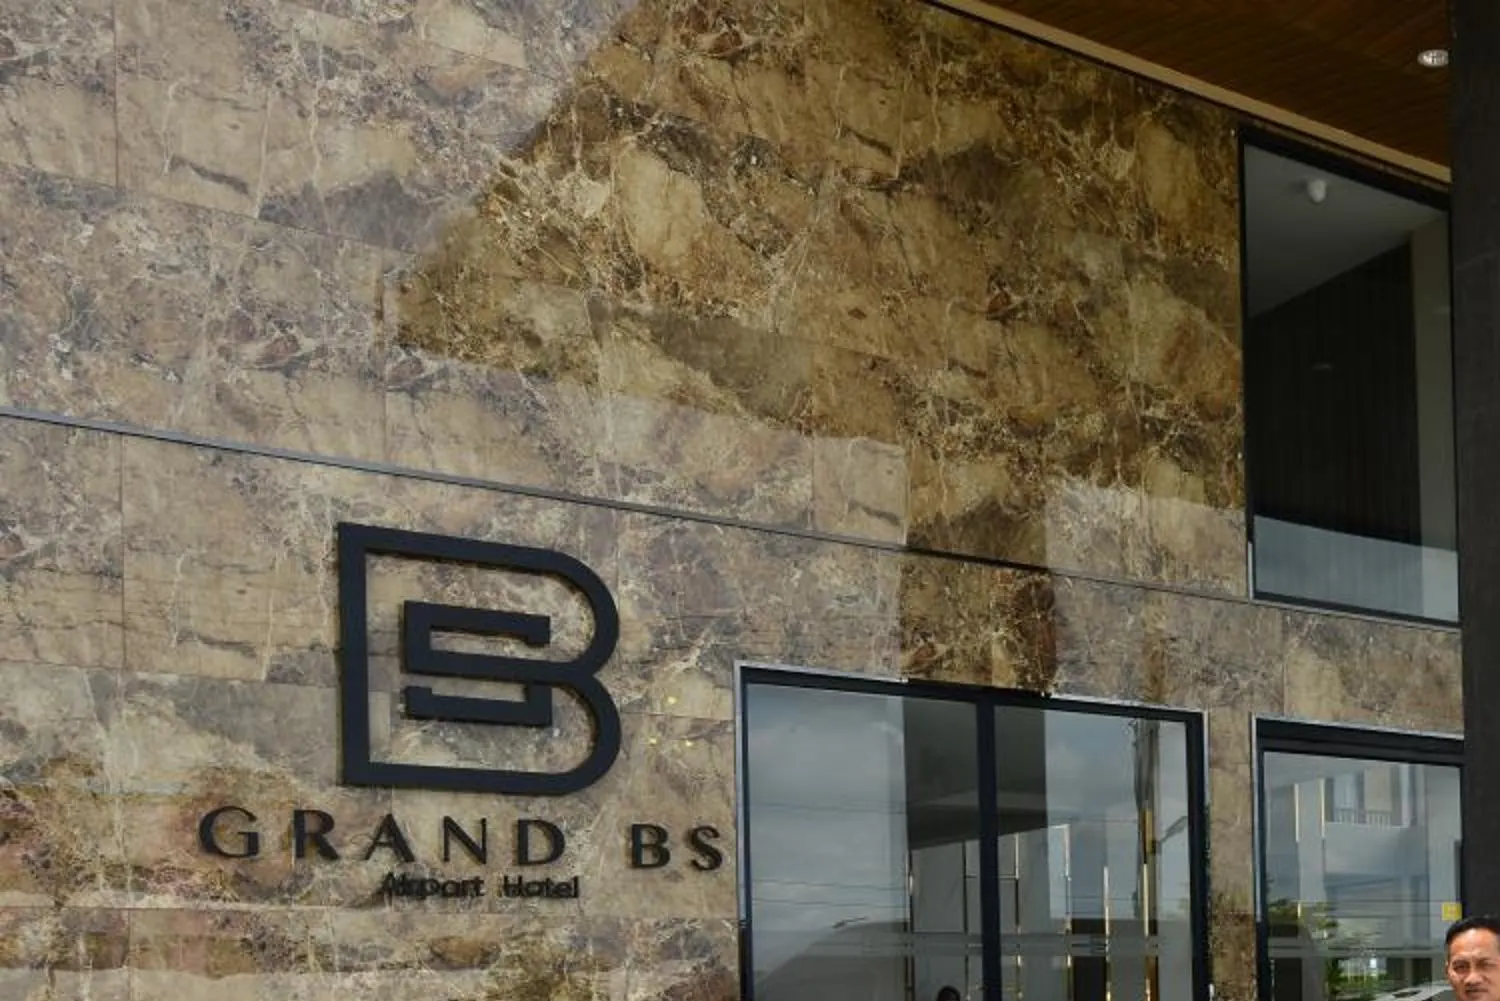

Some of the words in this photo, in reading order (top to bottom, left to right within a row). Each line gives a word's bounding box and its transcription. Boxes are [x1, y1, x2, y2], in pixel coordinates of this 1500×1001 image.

[199, 804, 567, 867] GRAND
[630, 822, 724, 872] BS
[501, 874, 580, 899] Hotel
